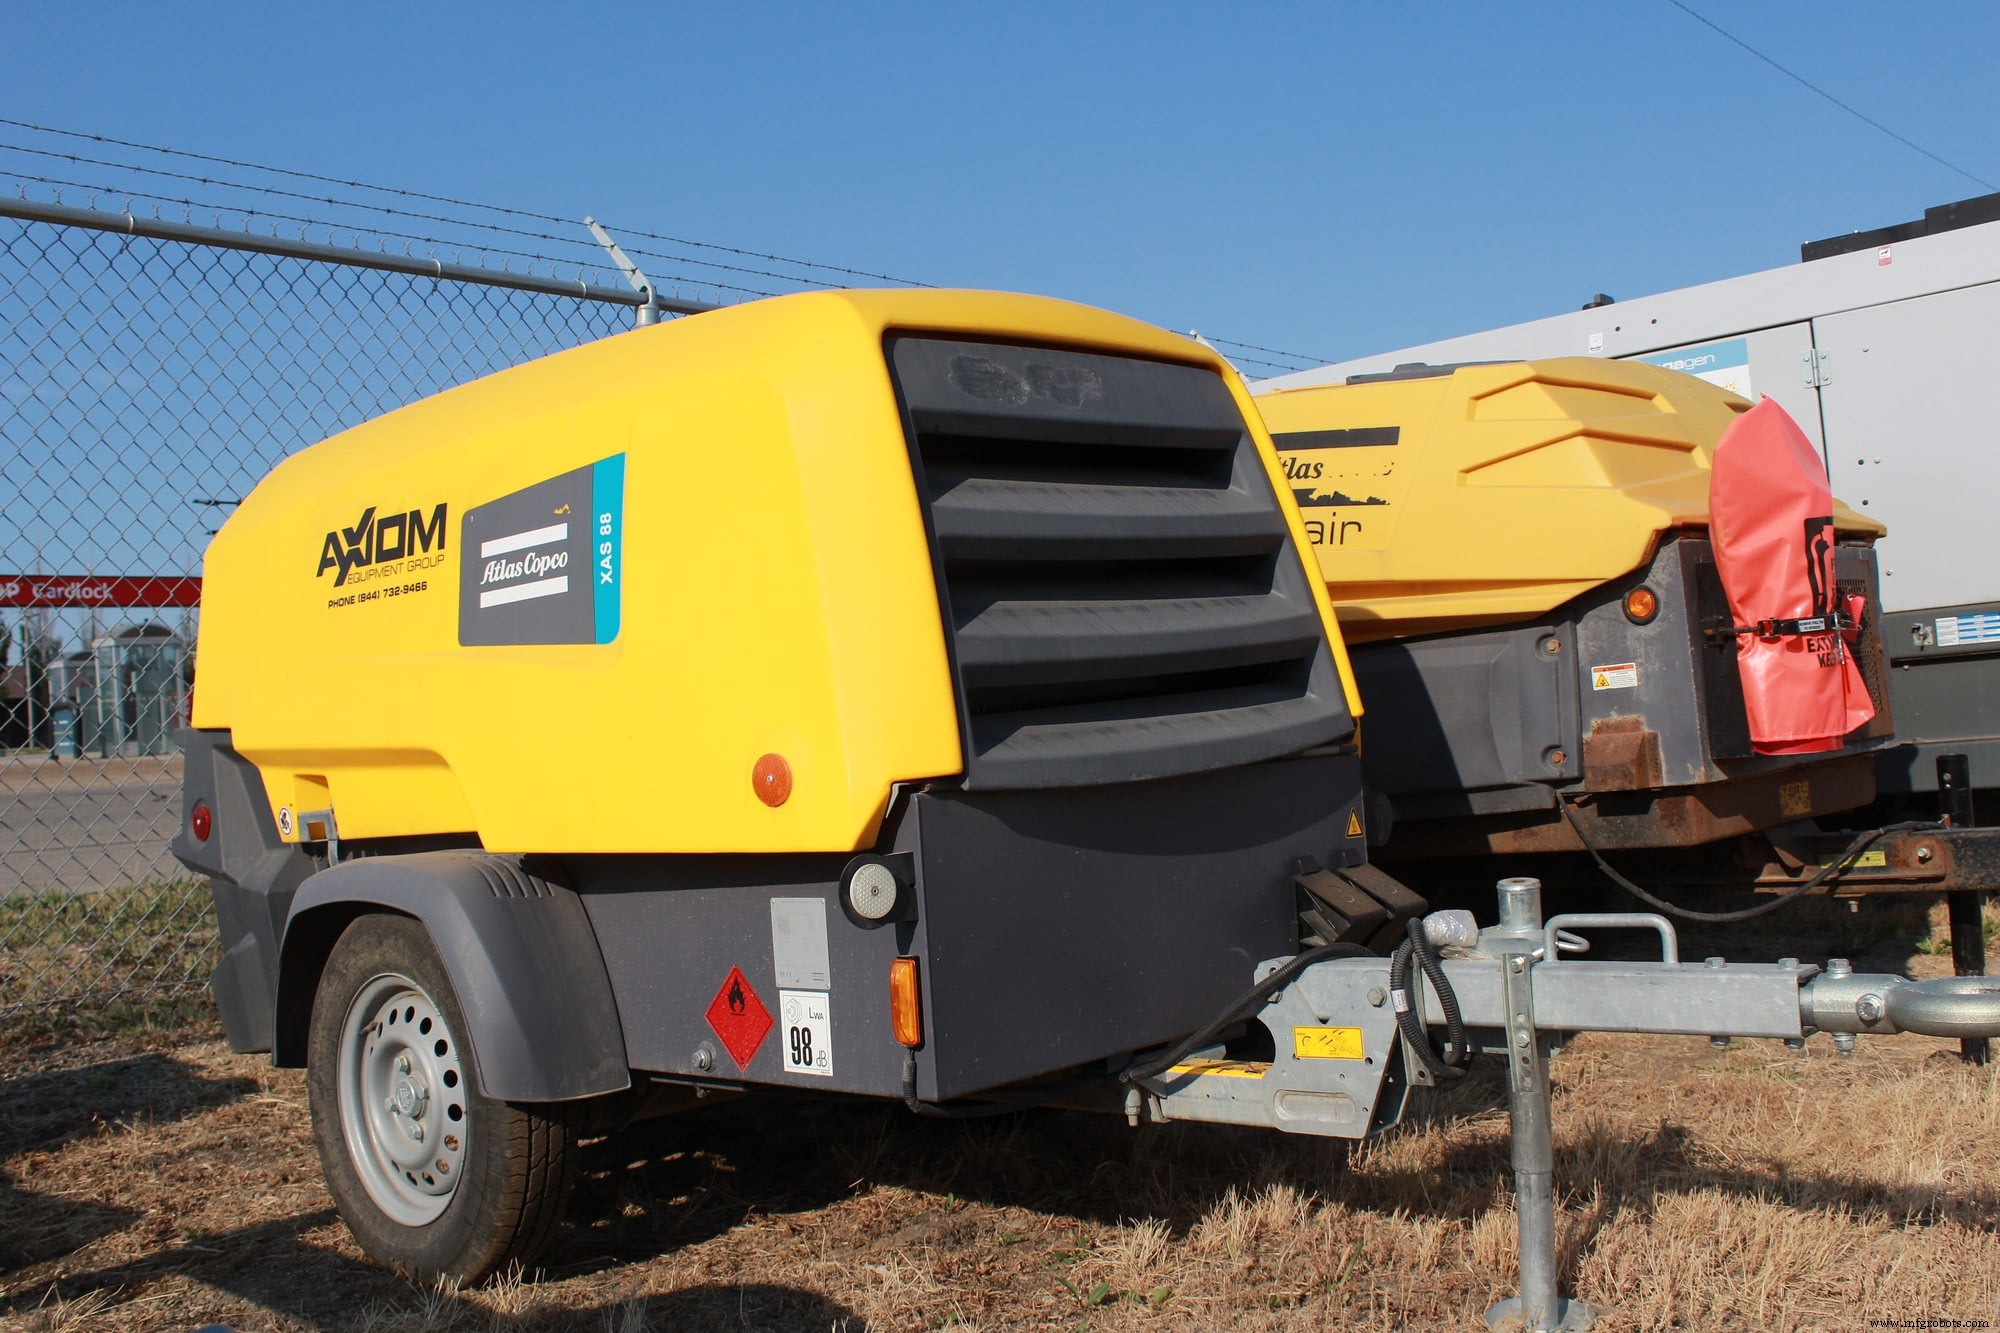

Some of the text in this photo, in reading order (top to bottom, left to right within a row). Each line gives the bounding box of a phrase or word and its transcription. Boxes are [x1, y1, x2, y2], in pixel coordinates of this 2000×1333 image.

[316, 502, 448, 588] AXIOM
[600, 512, 613, 585] XAS 88
[347, 554, 445, 585] EQUIPMENT GROUP
[480, 551, 568, 585] Atlas Copco
[32, 582, 113, 599] Cardlock
[328, 580, 428, 610] PHONE (844) 732-9466
[790, 1025, 813, 1067] 98
[816, 1049, 828, 1068] dB
